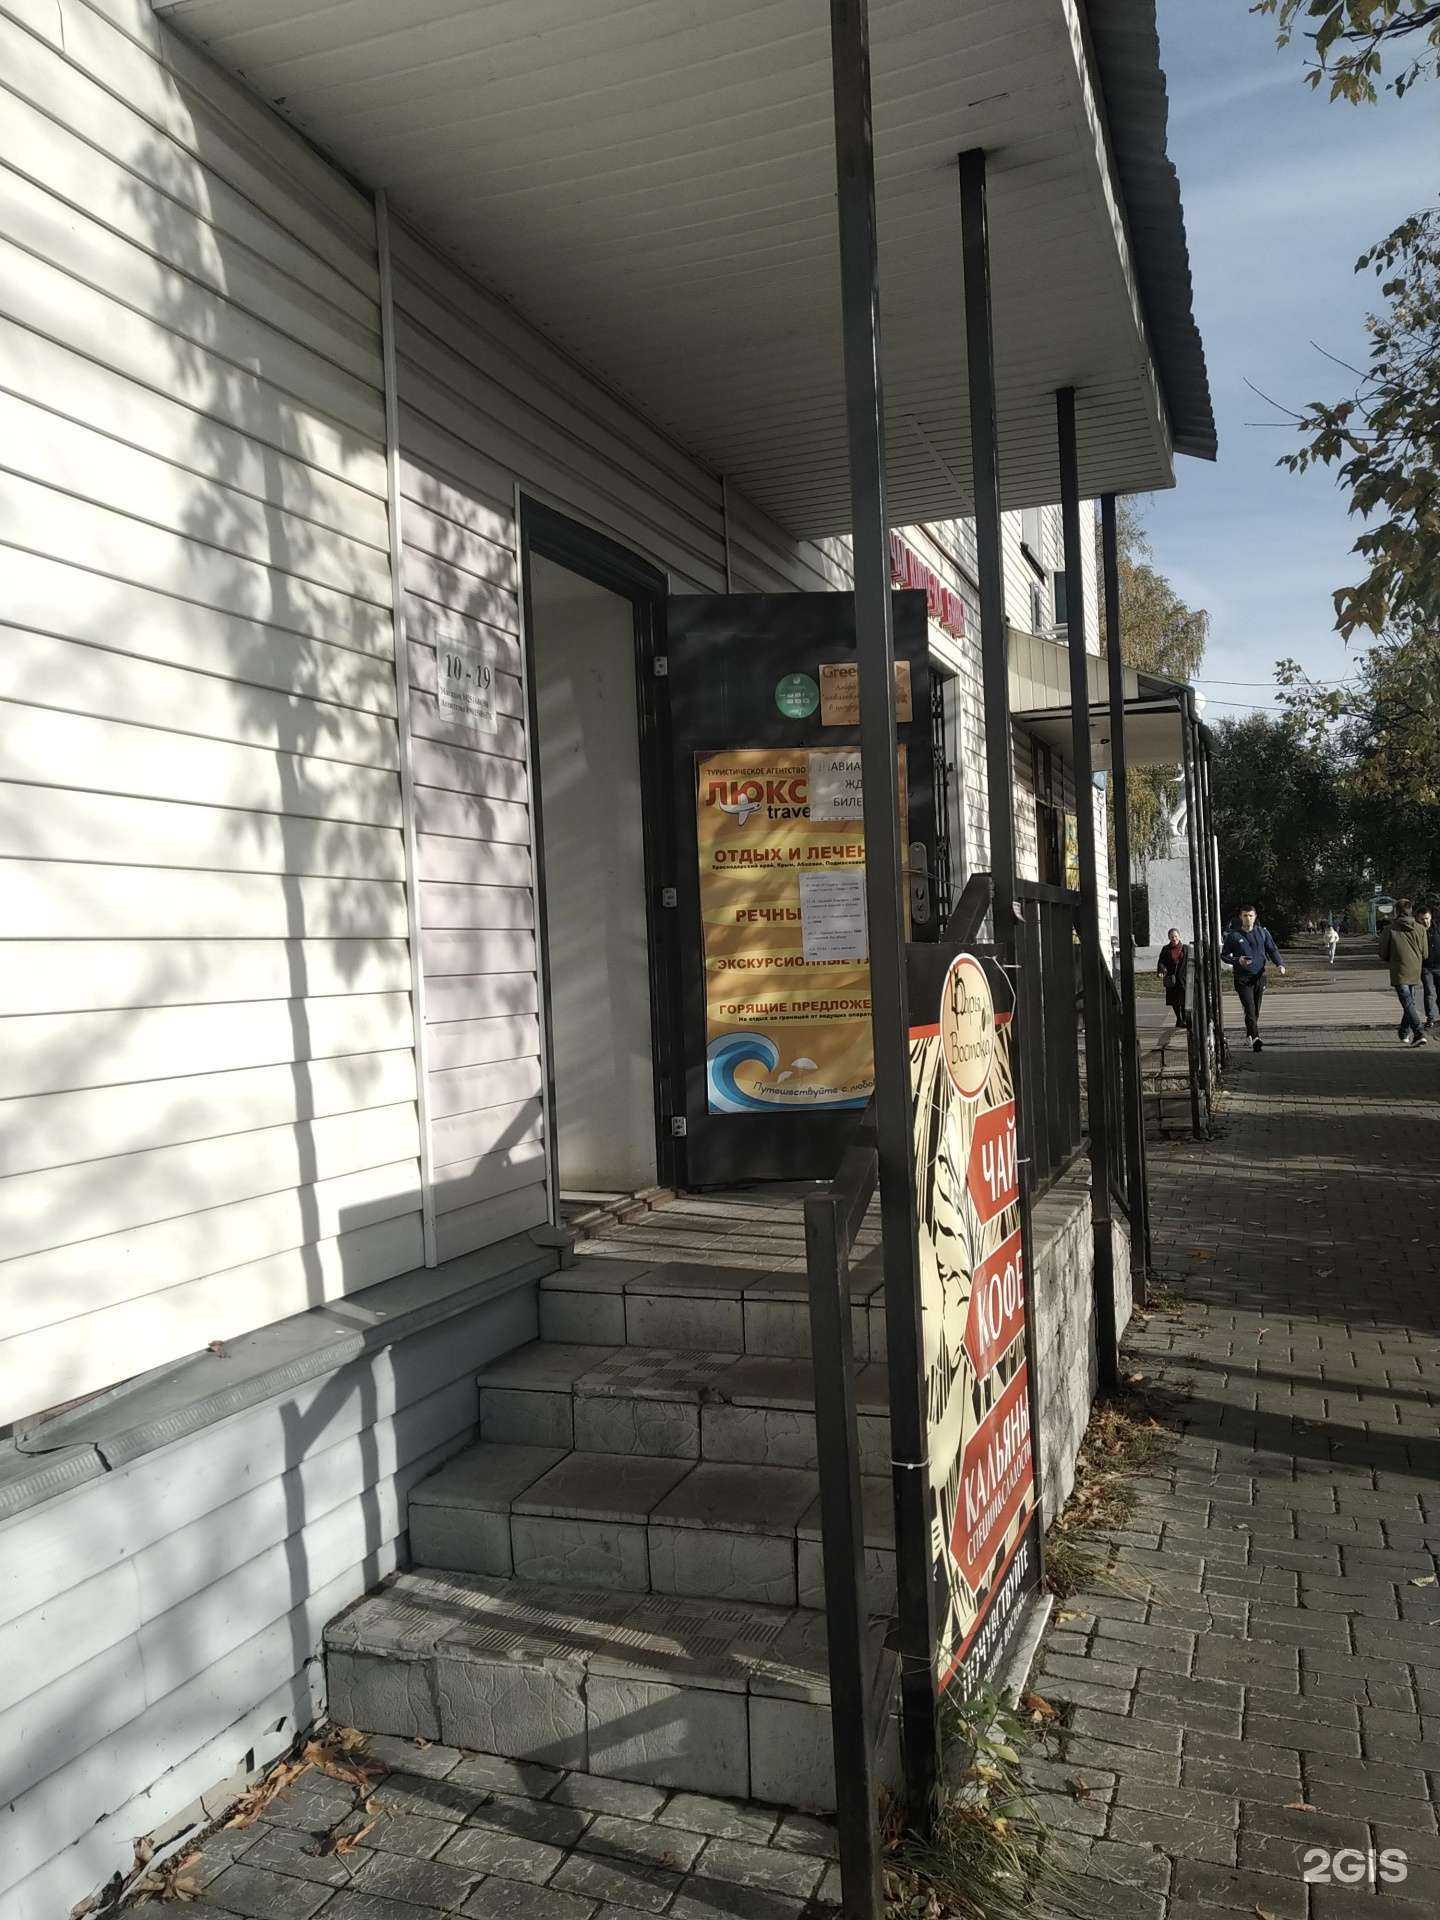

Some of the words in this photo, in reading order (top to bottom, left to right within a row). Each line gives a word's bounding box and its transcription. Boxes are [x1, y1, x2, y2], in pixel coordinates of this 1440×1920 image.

[706, 767, 765, 776] ТУРИСТИЧЕСКОЕ
[766, 766, 806, 775] АГЕНТСТВО
[705, 779, 808, 807] ЛЮКС
[833, 797, 862, 808] БИЛЕ
[768, 805, 811, 819] trave
[714, 848, 782, 864] ОТДЫХ
[788, 847, 800, 860] И
[807, 845, 865, 860] ЛЕЧЕН
[736, 908, 802, 922] РЕЧНЫ
[719, 1002, 787, 1014] ГОРЯЩИЕ
[791, 999, 872, 1013] ПРЕДЛОЖЕ
[753, 1081, 838, 1098] Путешествуйте
[849, 1080, 873, 1092] любо
[981, 1114, 1019, 1201] ЧАЙ
[976, 1249, 1024, 1357] КОФЕ
[964, 1385, 1030, 1532] КАЛЬЯНЫ
